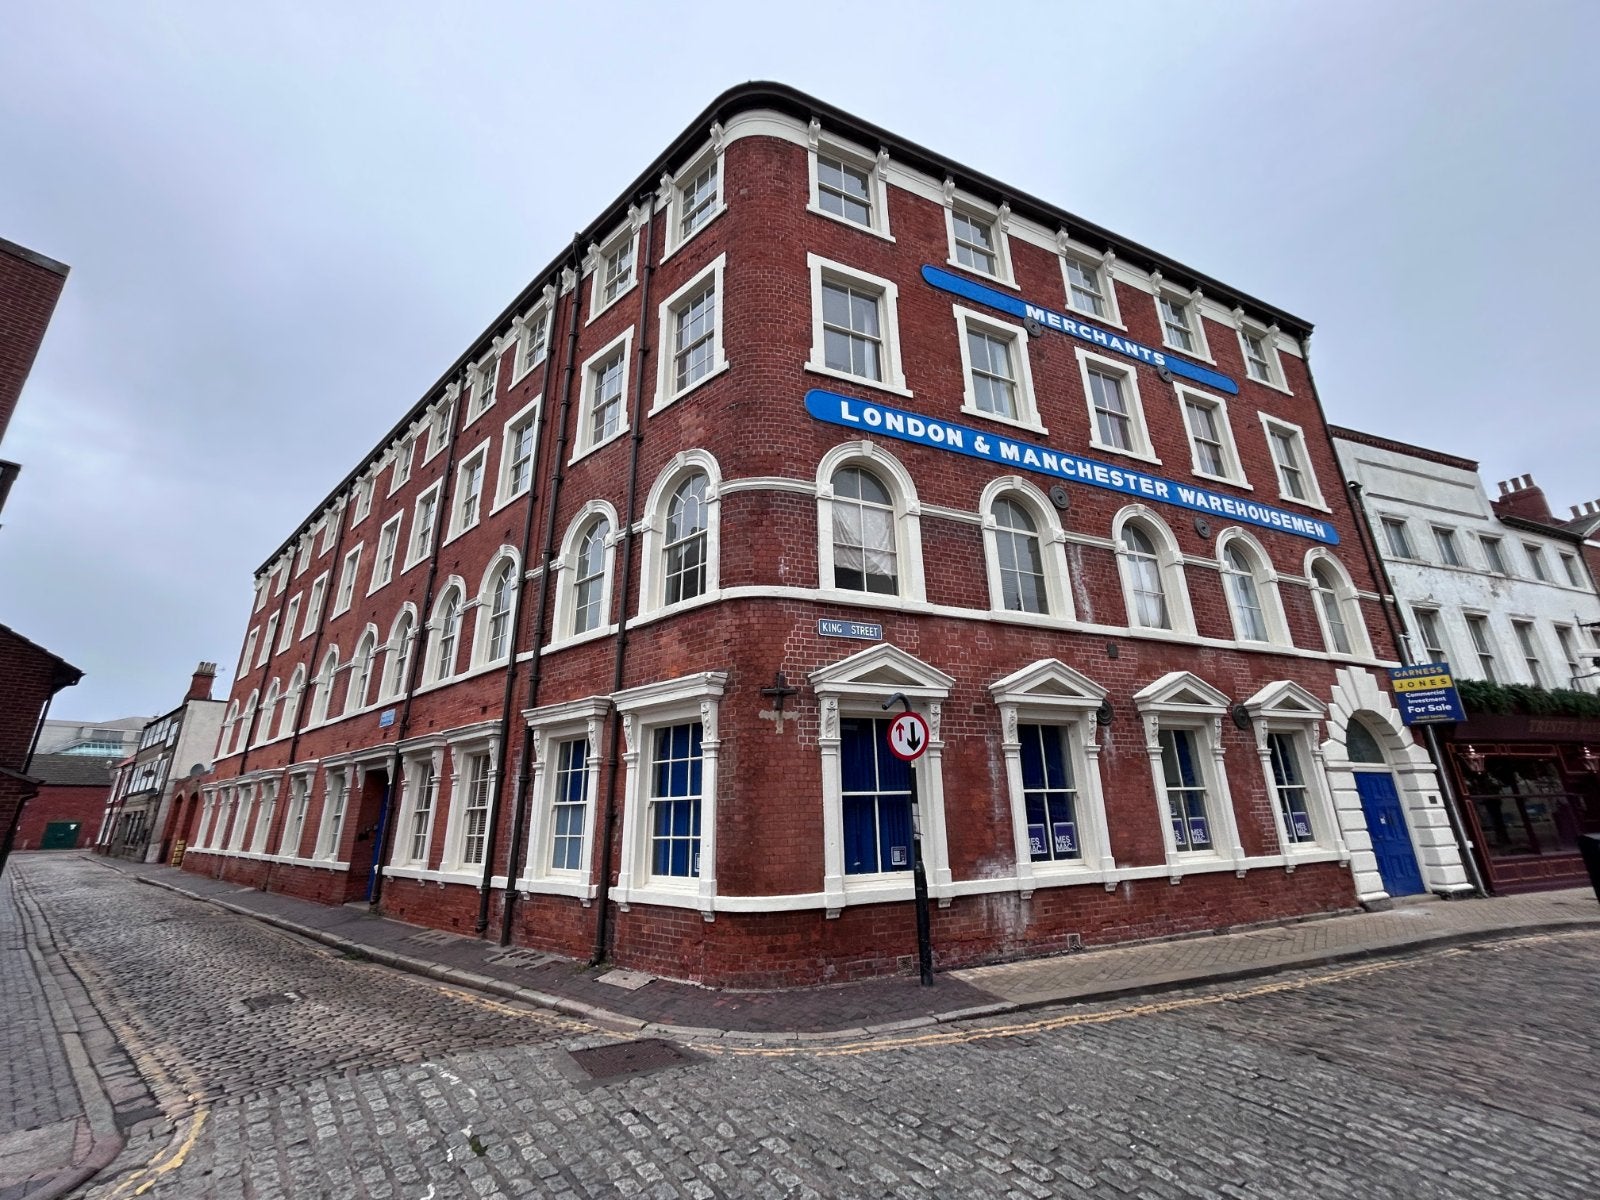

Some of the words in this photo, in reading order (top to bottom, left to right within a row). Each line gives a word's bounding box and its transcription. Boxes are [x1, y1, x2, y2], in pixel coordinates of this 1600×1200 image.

[1025, 304, 1166, 366] MERCHANTS
[840, 401, 964, 448] LONDON
[973, 436, 991, 454] &
[999, 441, 1170, 499] MANCHESTER
[1177, 487, 1327, 538] WAREHOUSEMEN
[822, 622, 842, 633] KING
[851, 625, 878, 637] STREET
[1394, 667, 1443, 678] GARNESS
[1398, 679, 1447, 689] JONES
[1405, 689, 1446, 698] Commercial
[1407, 705, 1426, 713] For
[1427, 704, 1452, 712] Sale
